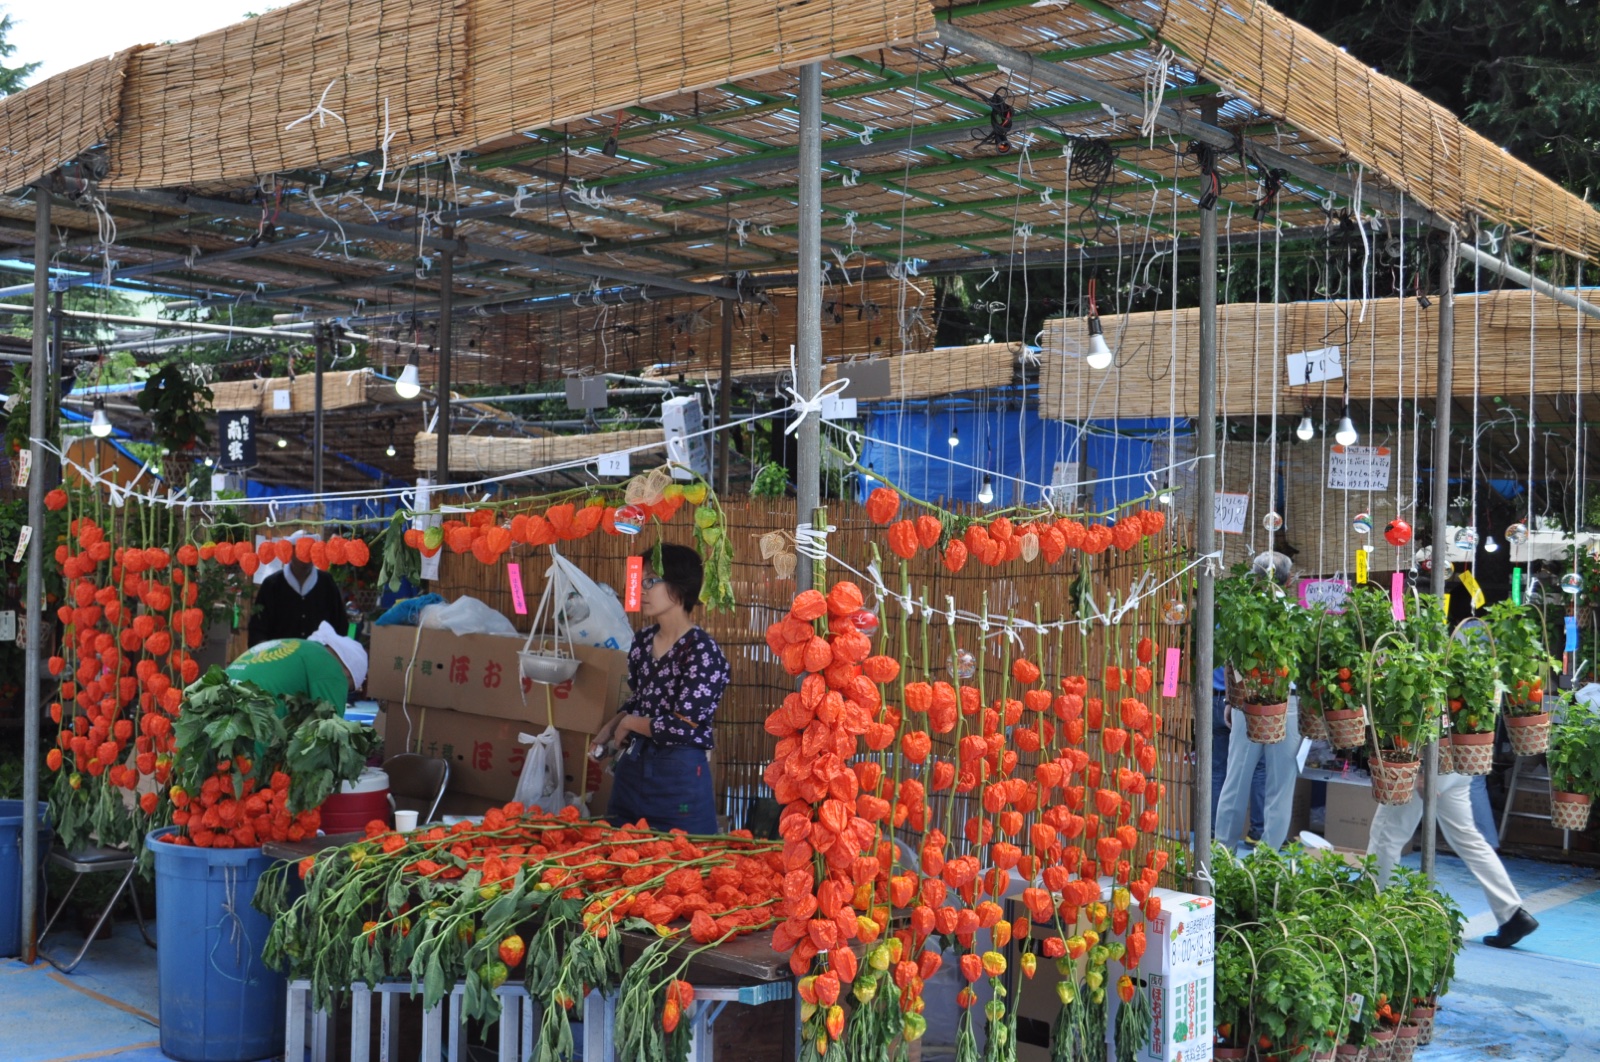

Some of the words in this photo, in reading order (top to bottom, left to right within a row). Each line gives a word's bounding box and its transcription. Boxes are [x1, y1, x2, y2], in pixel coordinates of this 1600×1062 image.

[609, 460, 620, 470] 72
[1152, 987, 1162, 1054] ほおずき市
